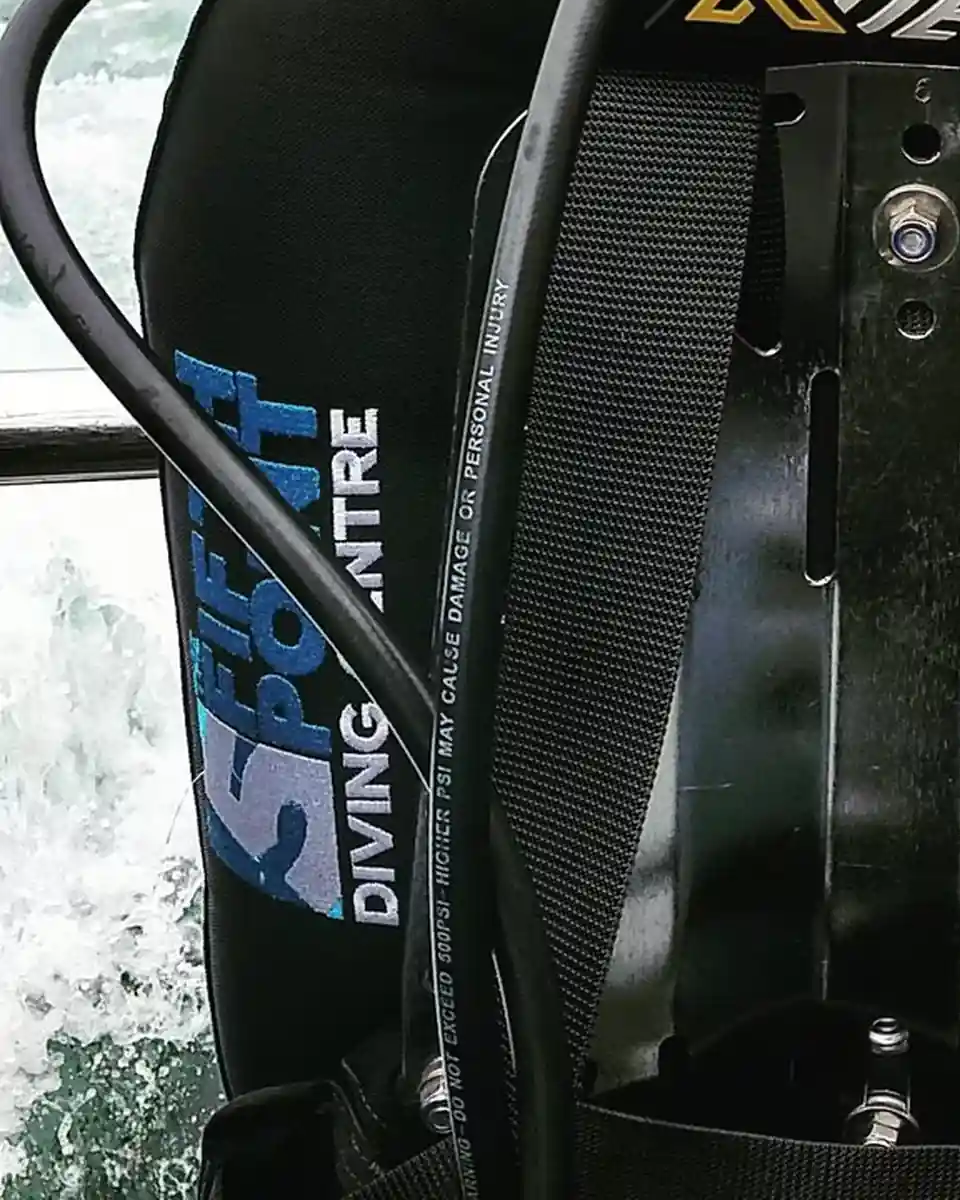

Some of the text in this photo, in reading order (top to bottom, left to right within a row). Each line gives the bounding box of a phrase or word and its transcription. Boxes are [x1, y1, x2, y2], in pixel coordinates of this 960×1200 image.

[482, 277, 510, 356] INJURY
[463, 365, 495, 481] PERSONAL
[458, 489, 477, 521] OR
[448, 529, 472, 624] DAMAGE
[329, 407, 400, 927] DIVING NTRE
[441, 631, 461, 705] CAUSE
[437, 712, 456, 758] MAY
[436, 766, 453, 800] PSI
[438, 971, 459, 1047] EXCEED
[446, 1051, 465, 1091] NOT
